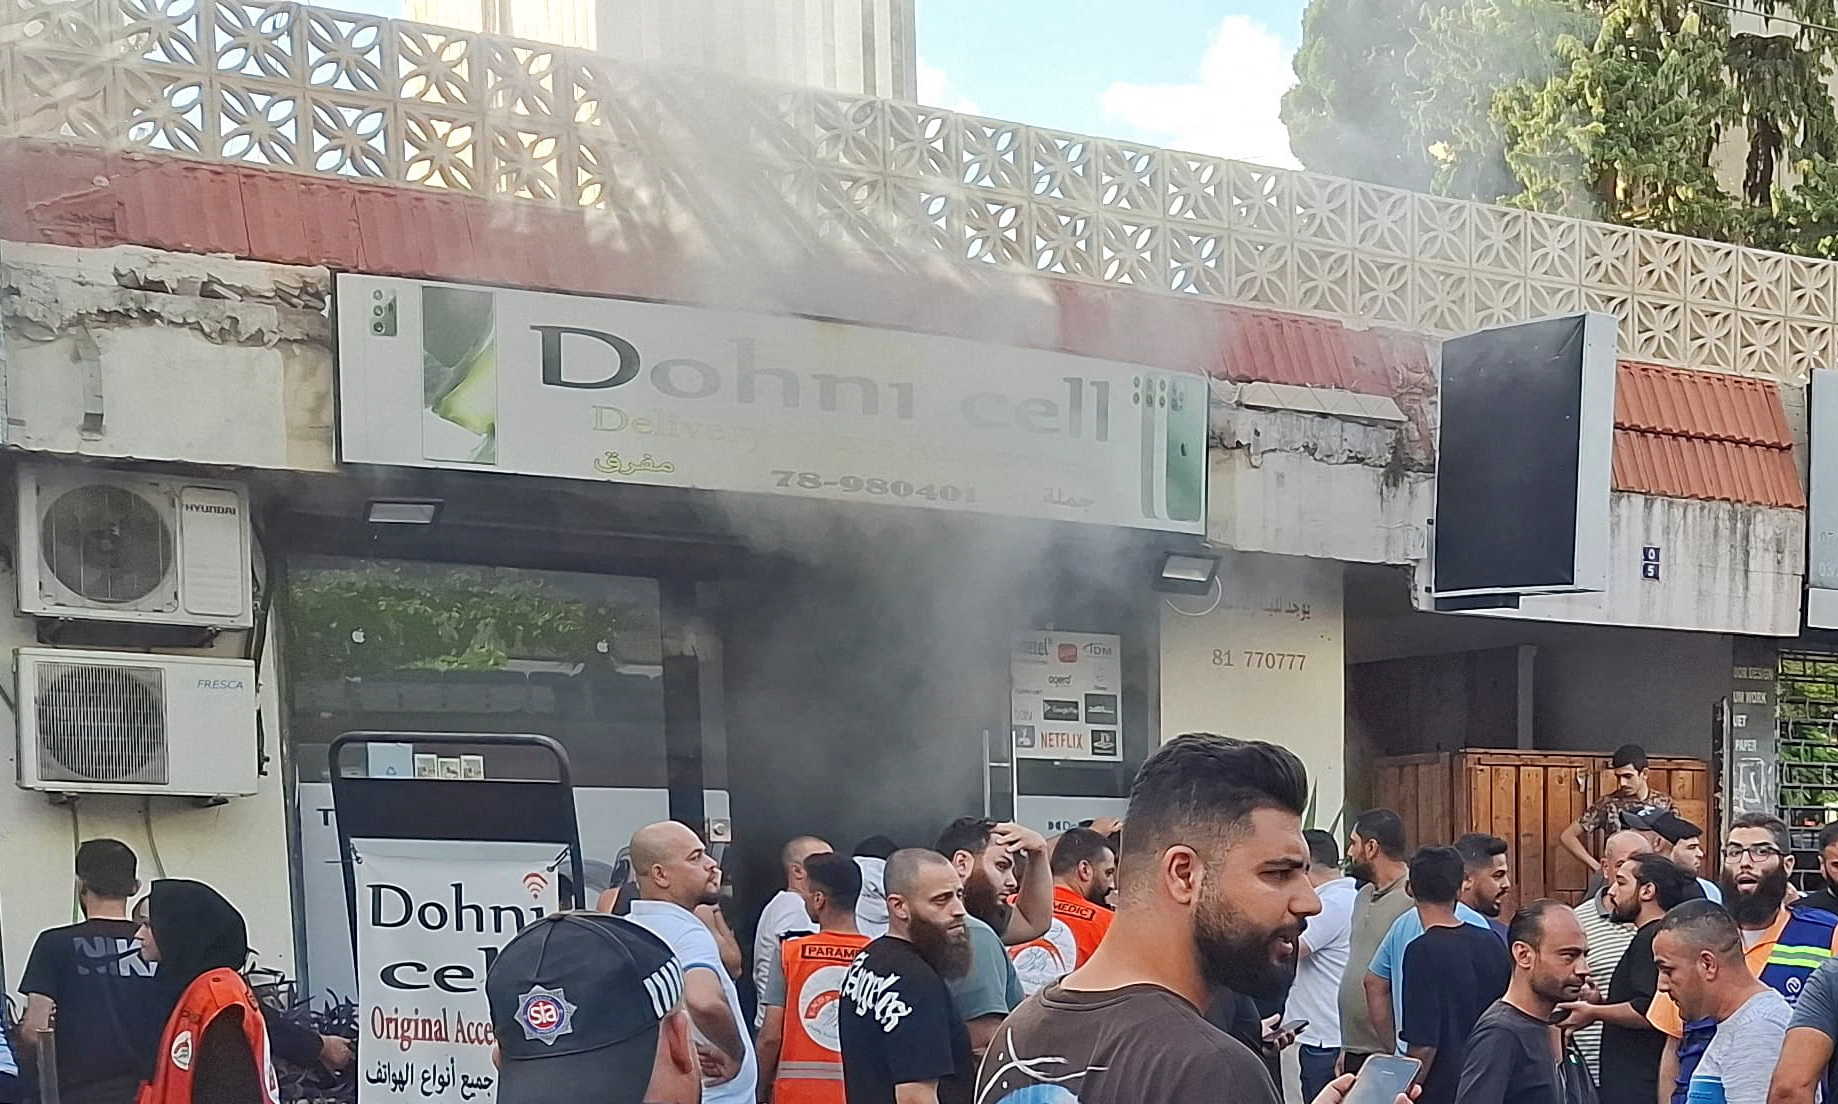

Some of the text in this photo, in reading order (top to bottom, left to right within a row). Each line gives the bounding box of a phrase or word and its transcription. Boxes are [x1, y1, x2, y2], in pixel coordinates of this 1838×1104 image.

[960, 376, 1110, 442] cell
[594, 451, 676, 475] مفرق
[770, 469, 976, 503] 78-980401
[185, 503, 237, 517] HYUNDAI
[1211, 648, 1307, 672] 81 770777
[196, 679, 244, 690] FRESCA
[1040, 731, 1084, 750] NETFLIX
[72, 936, 158, 977] NIK
[530, 1001, 558, 1025] sia
[371, 1004, 449, 1051] Original
[365, 1056, 494, 1101] جميع أنواع الهواتف
